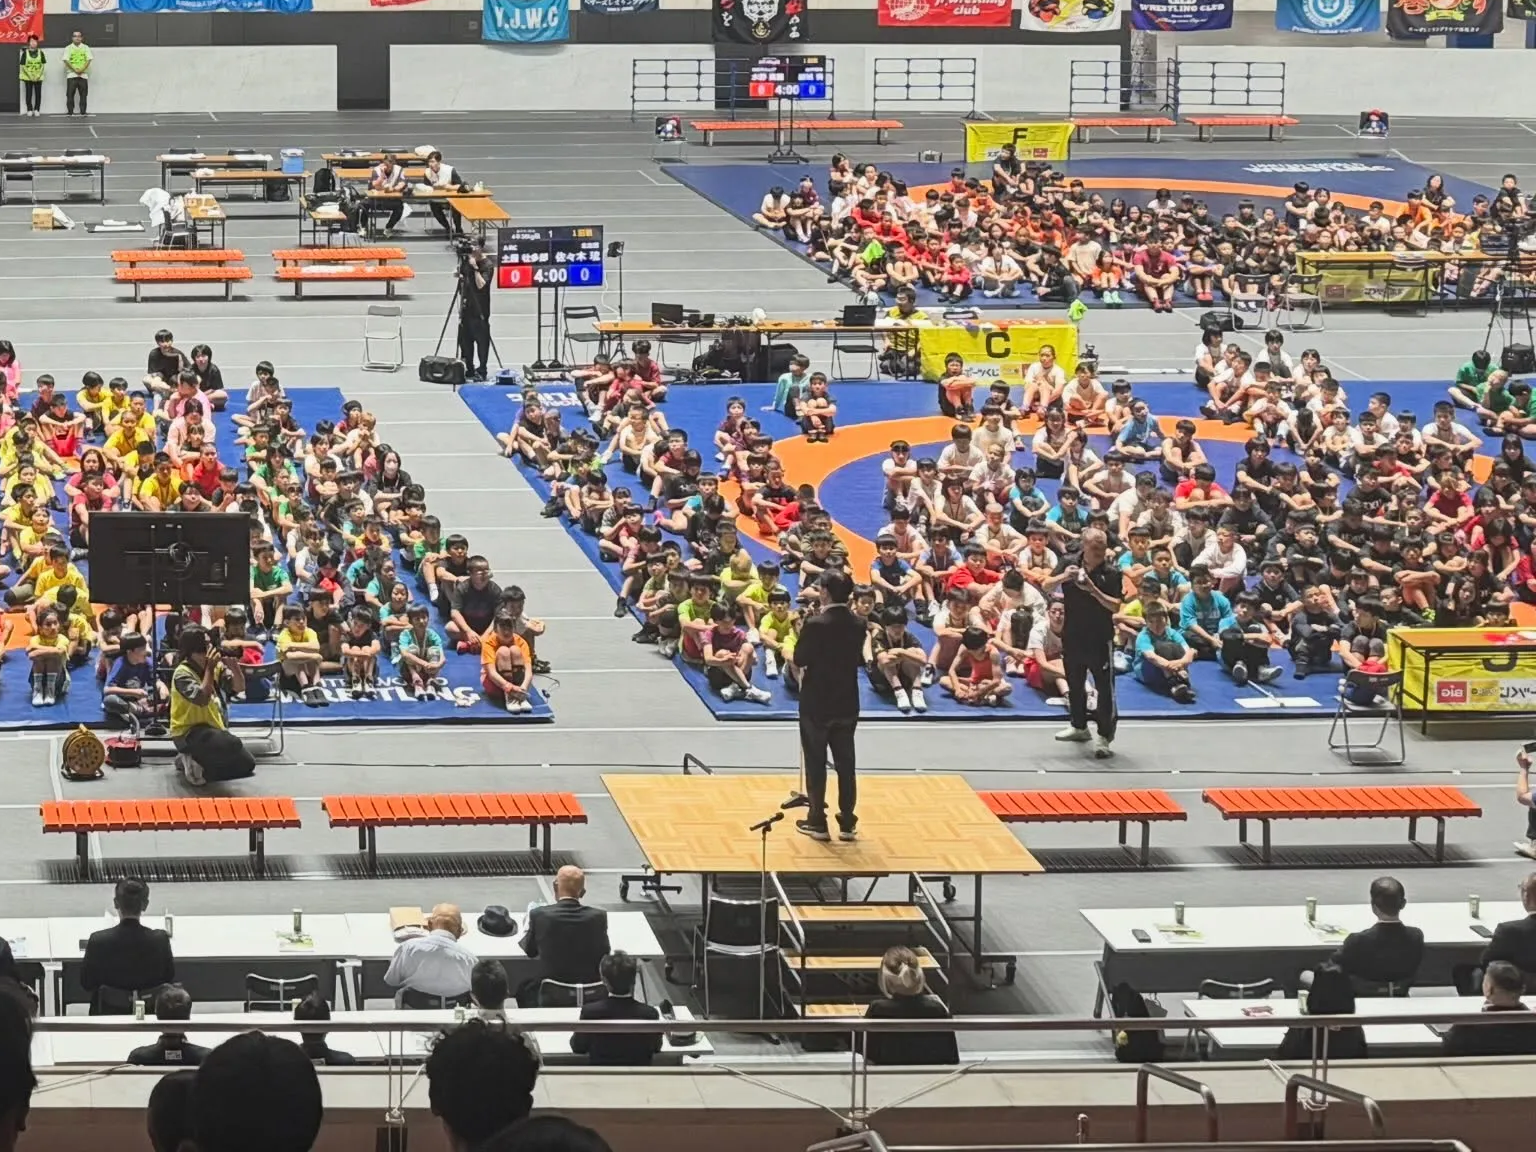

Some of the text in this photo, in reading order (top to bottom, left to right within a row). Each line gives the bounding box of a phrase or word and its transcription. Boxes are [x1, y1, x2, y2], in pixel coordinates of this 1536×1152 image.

[953, 5, 981, 15] club
[1139, 3, 1225, 13] WRESTLING CLUB
[774, 84, 800, 95] 4:00
[808, 84, 816, 95] 0
[1013, 127, 1028, 145] F
[555, 251, 587, 262] 佐々木
[510, 267, 590, 283] 0 4:00 0
[985, 332, 1011, 359] C
[964, 365, 1000, 378] ポーツくじ
